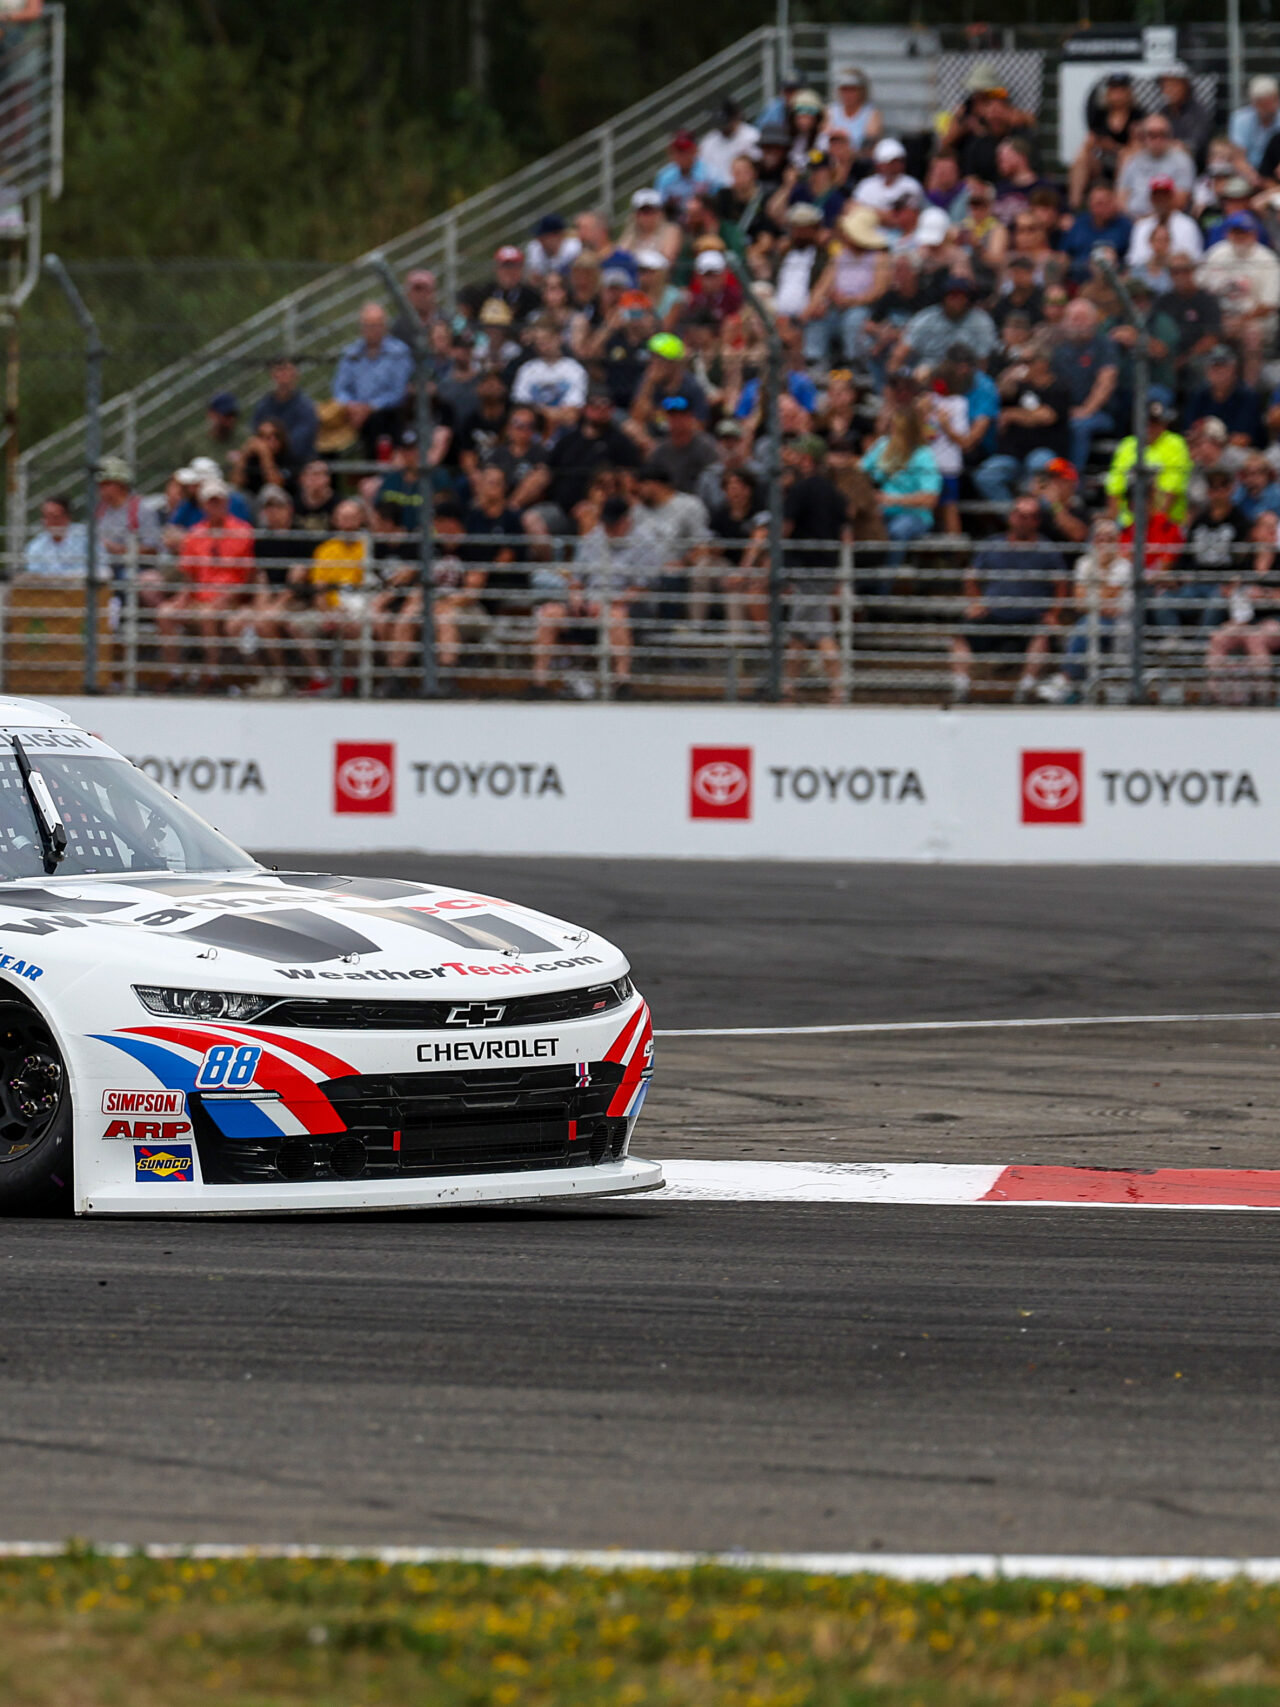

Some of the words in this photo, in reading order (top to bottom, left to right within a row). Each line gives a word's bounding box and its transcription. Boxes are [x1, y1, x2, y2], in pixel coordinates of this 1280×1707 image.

[412, 762, 565, 796] TOYOTA
[769, 766, 926, 803] TOYOTA
[1101, 770, 1259, 806] TOYOTA
[273, 953, 604, 982] WeatherTech.com
[416, 1037, 559, 1063] CHEVROLET
[198, 1045, 263, 1086] 88
[106, 1092, 178, 1112] SIMPSON
[102, 1119, 192, 1139] ARP
[138, 1158, 189, 1170] SUNOCO
